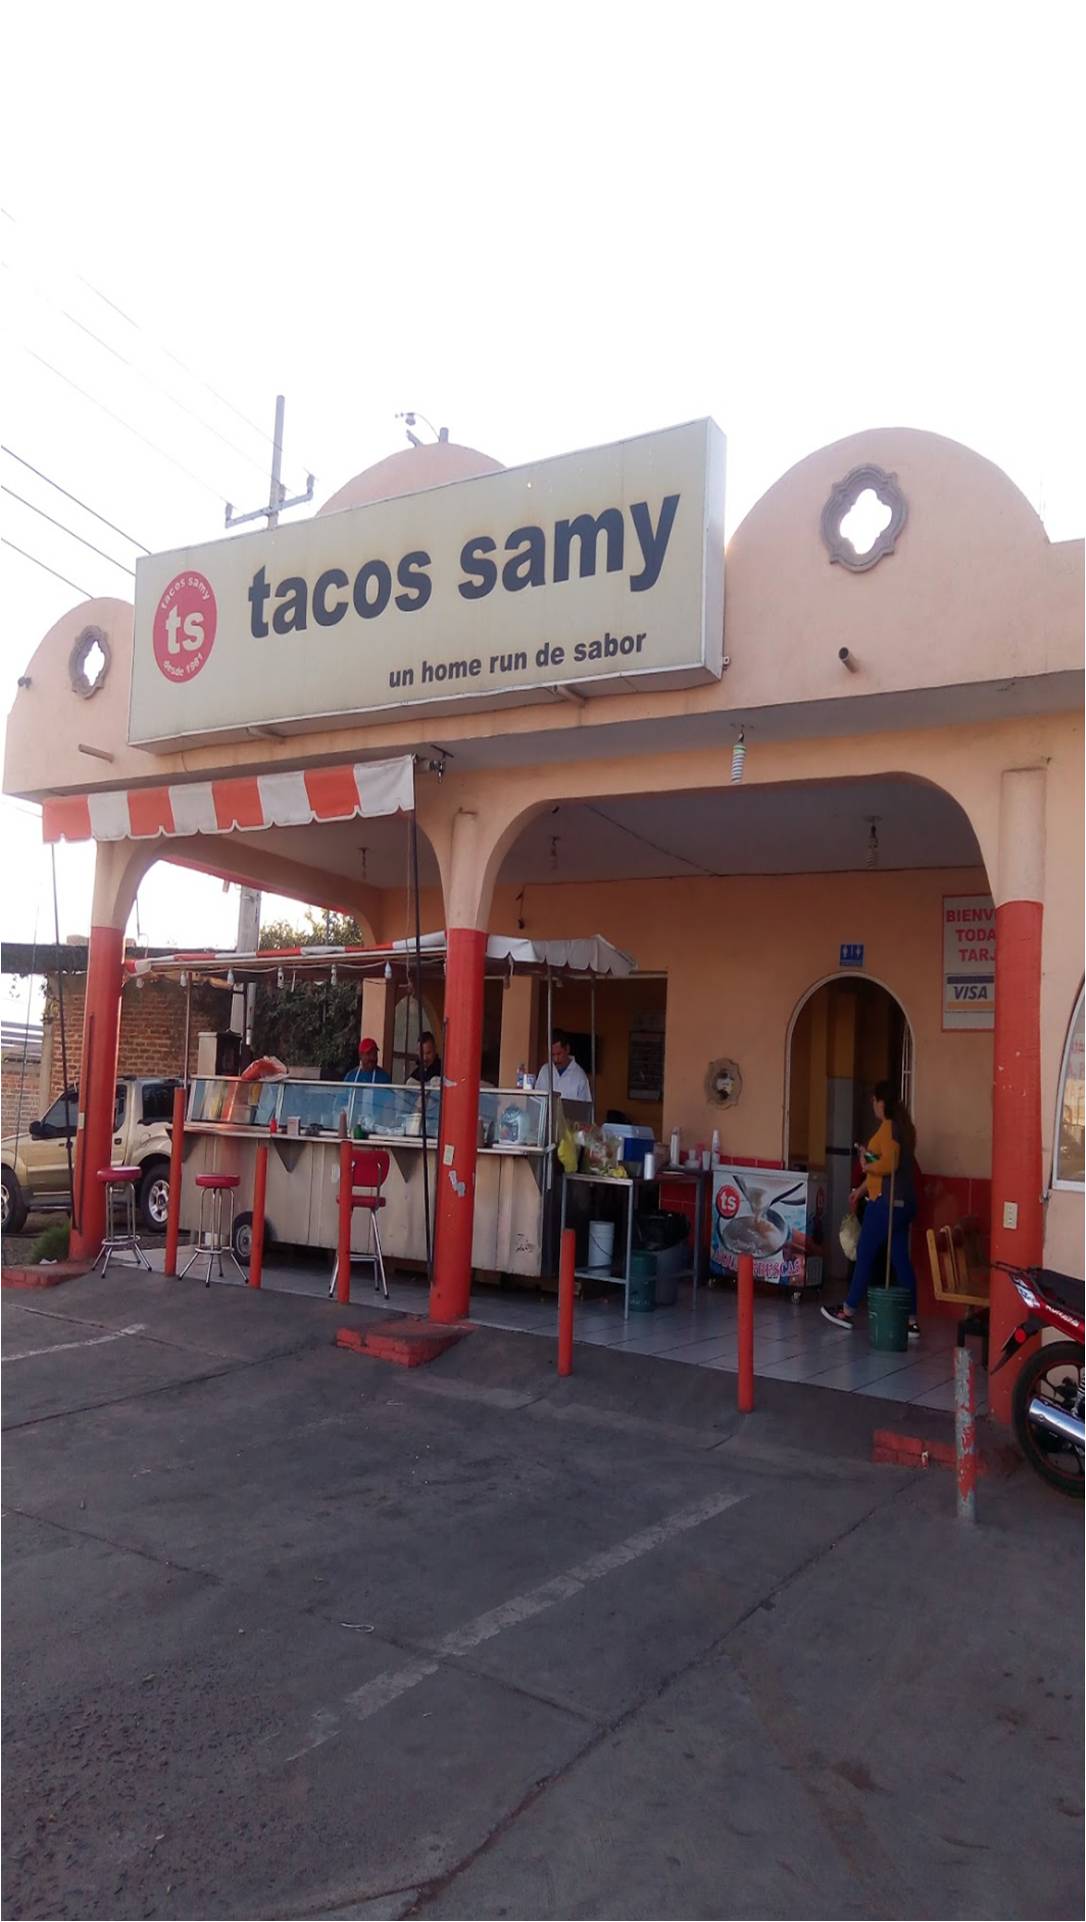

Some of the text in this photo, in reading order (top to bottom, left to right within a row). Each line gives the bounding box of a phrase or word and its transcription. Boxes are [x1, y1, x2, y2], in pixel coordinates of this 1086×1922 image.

[248, 494, 681, 638] tacos samy
[161, 576, 210, 609] tacos samy
[165, 605, 205, 654] ts
[163, 660, 185, 676] desde
[389, 632, 647, 688] un home run de sabor
[946, 909, 997, 922] BIENV
[953, 985, 988, 1000] VISA
[720, 1191, 736, 1210] ts
